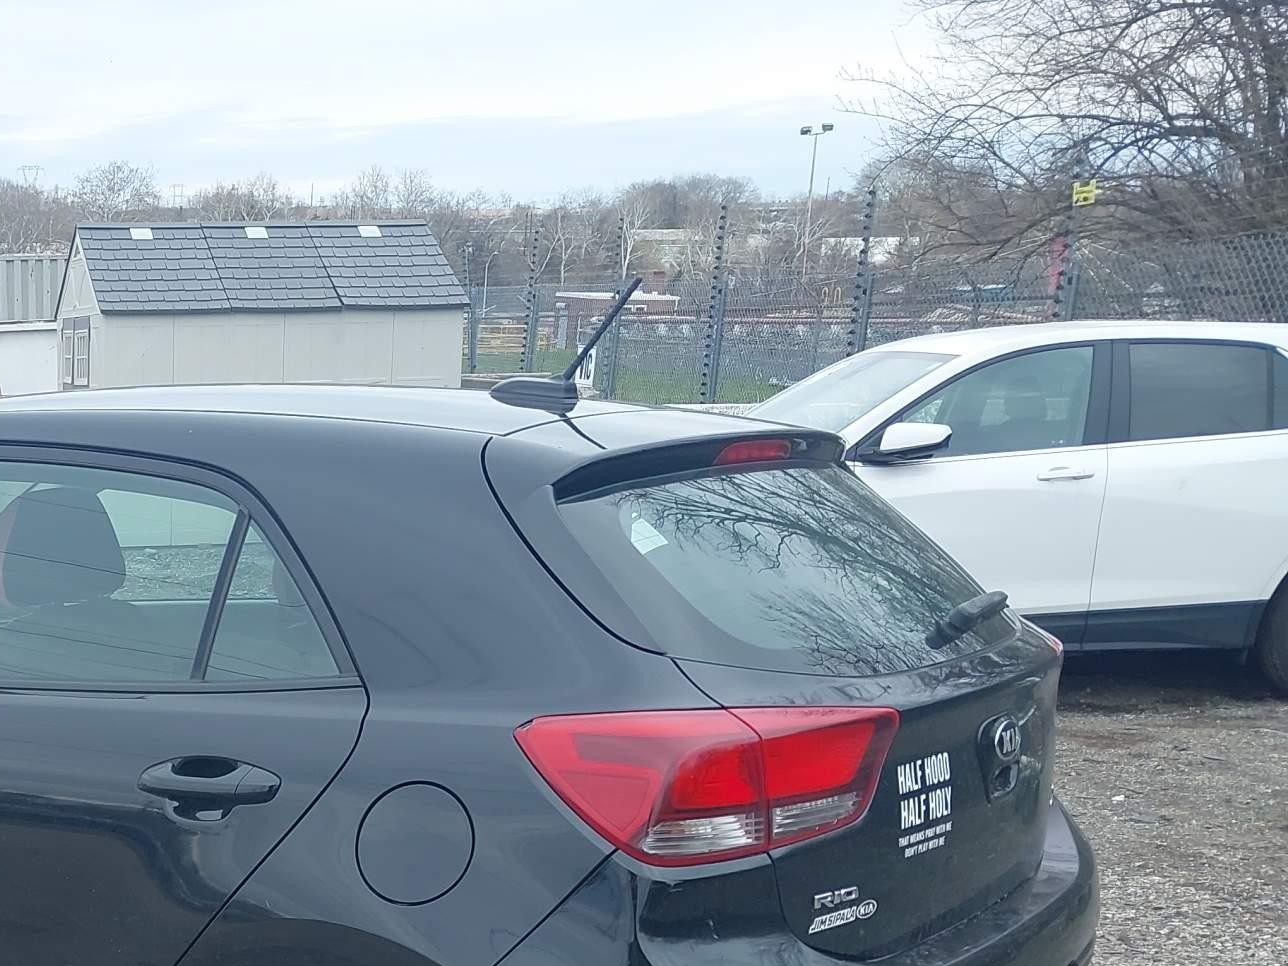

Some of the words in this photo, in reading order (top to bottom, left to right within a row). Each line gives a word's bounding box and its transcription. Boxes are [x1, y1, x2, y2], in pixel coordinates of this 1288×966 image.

[897, 759, 922, 795] HALF
[924, 752, 951, 786] HOOD
[900, 794, 926, 830] HALF
[929, 786, 952, 821] HOLY
[814, 886, 859, 909] RIO
